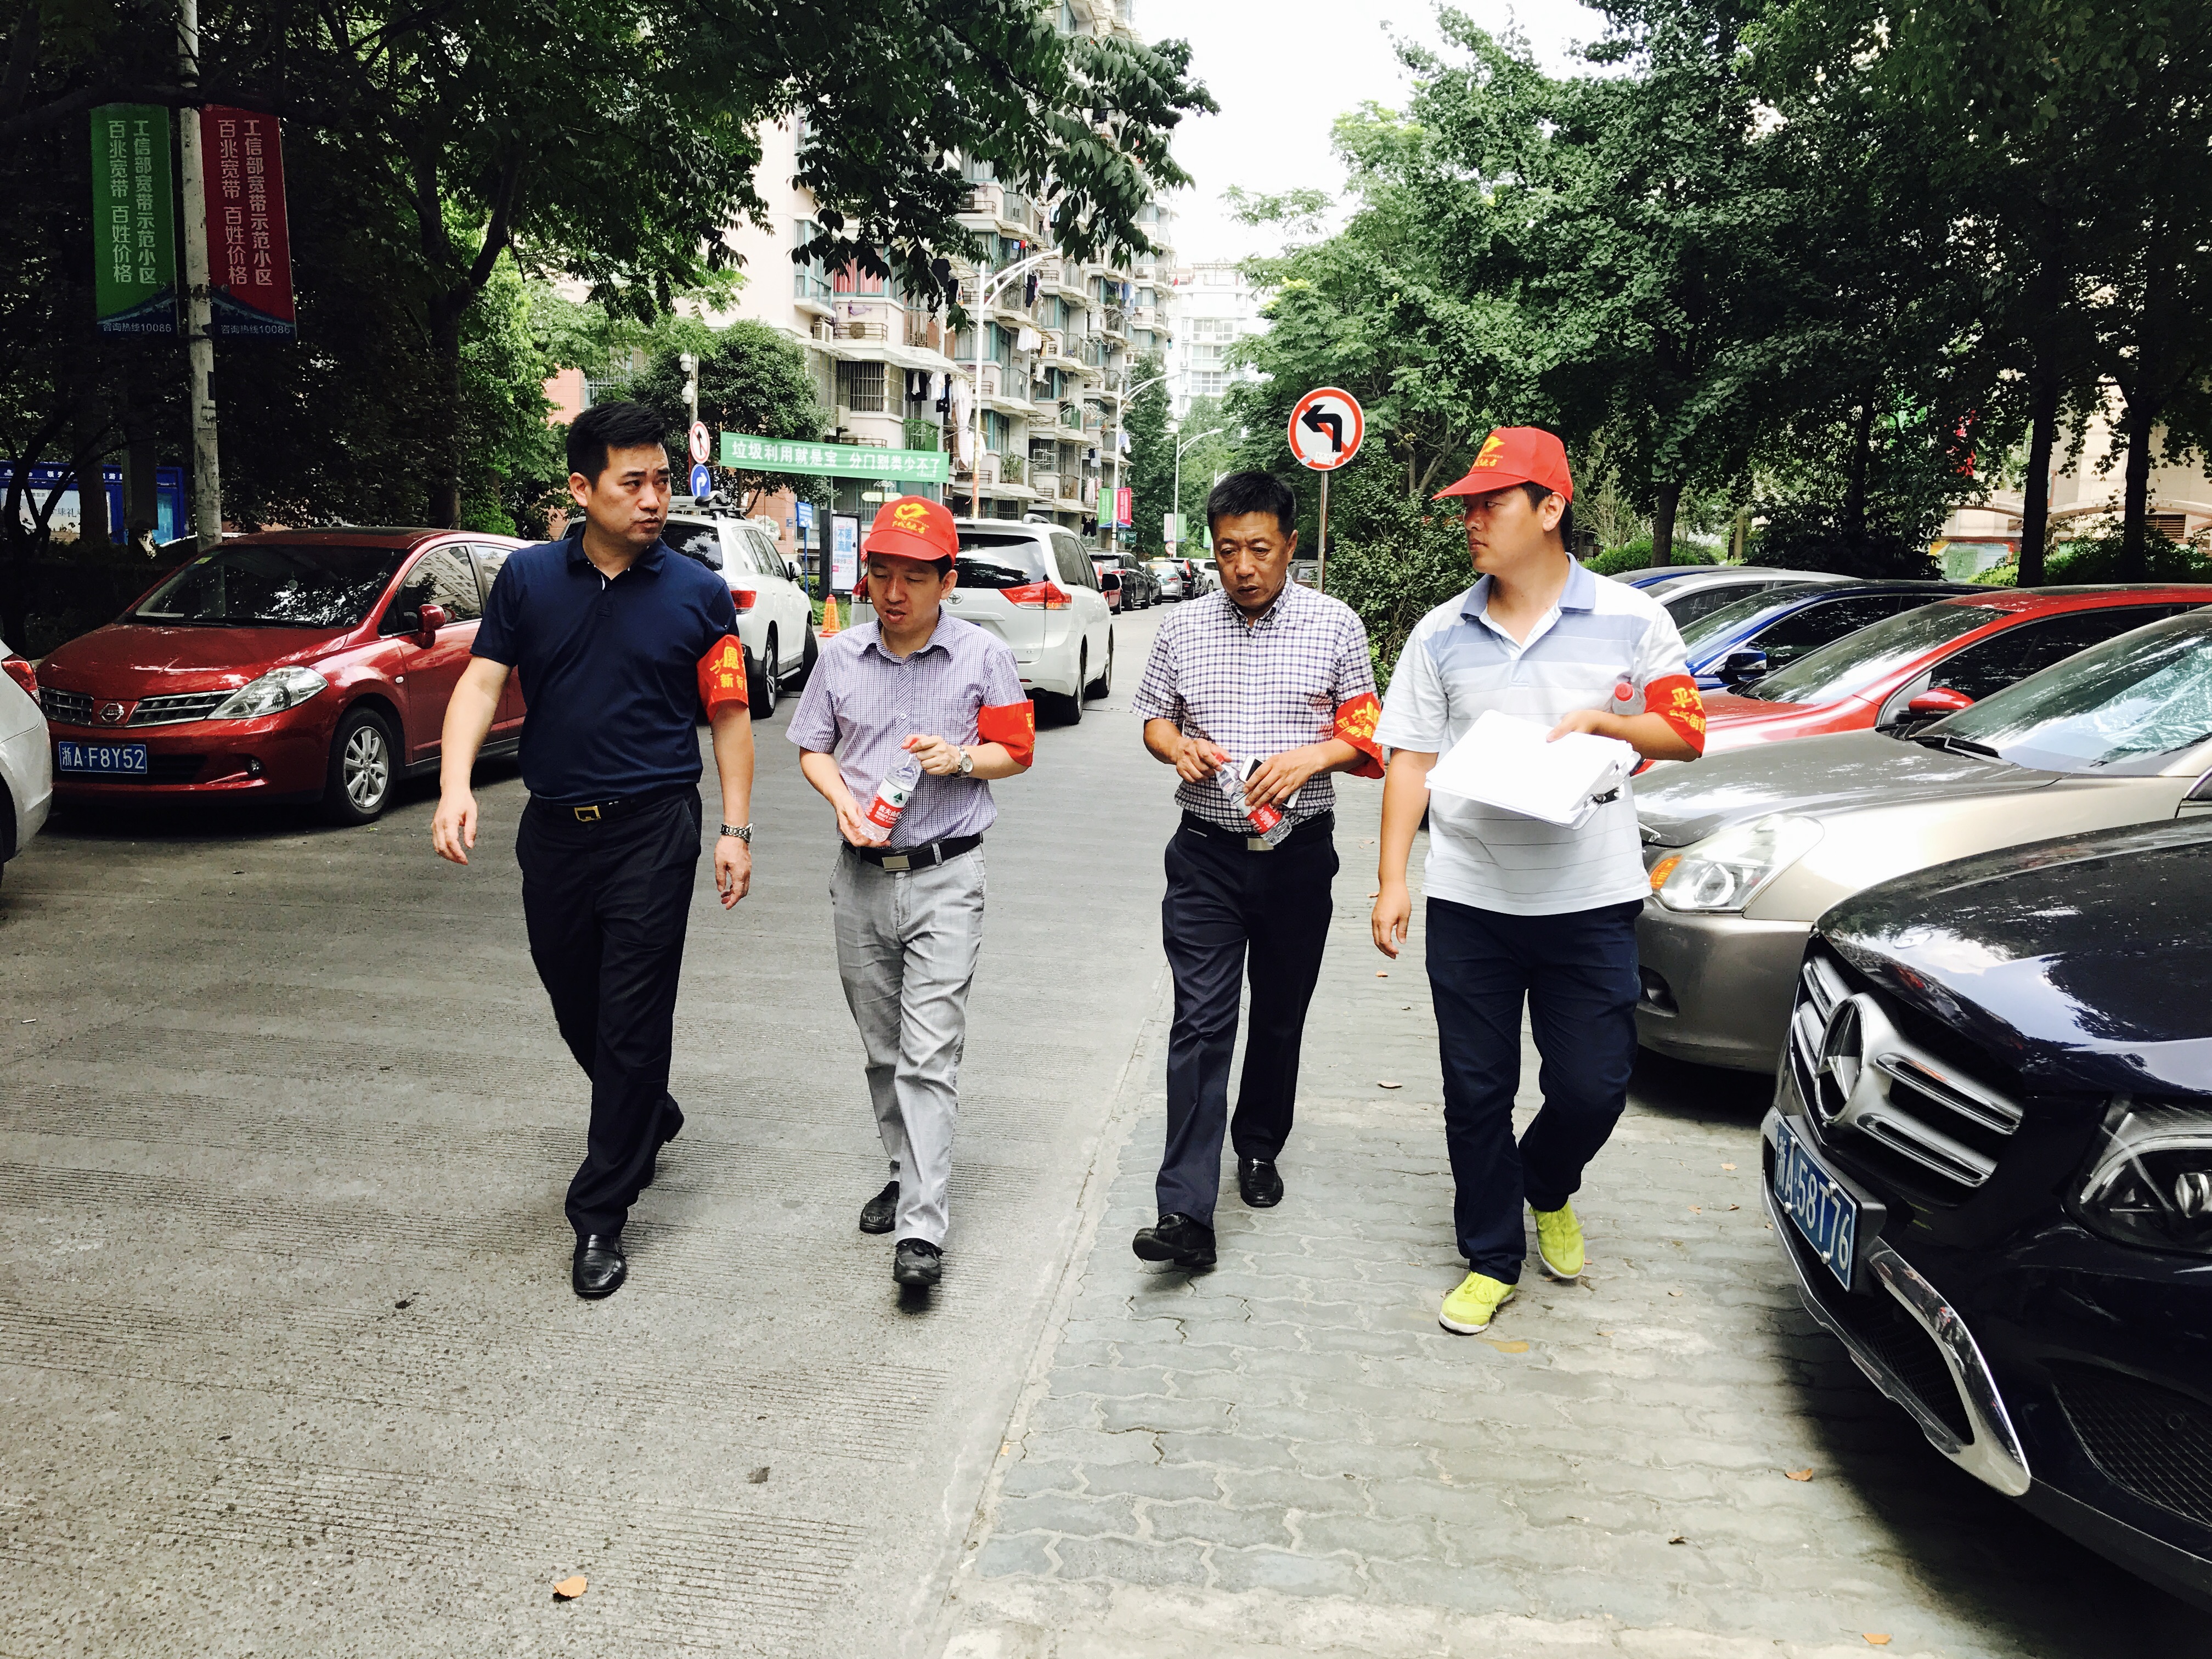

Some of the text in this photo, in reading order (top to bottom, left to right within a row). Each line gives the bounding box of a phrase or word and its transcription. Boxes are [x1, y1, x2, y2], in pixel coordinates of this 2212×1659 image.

[108, 120, 132, 284] 百兆宽带 百姓价格
[133, 120, 157, 284] 工信部宽带示范小区
[218, 120, 248, 285] 百兆宽带 百姓价格
[244, 120, 273, 285] 工信部宽带示范小区
[103, 323, 172, 332] 咨询热线10086
[732, 440, 941, 473] 垃圾利用就是宝 分门别类少不了
